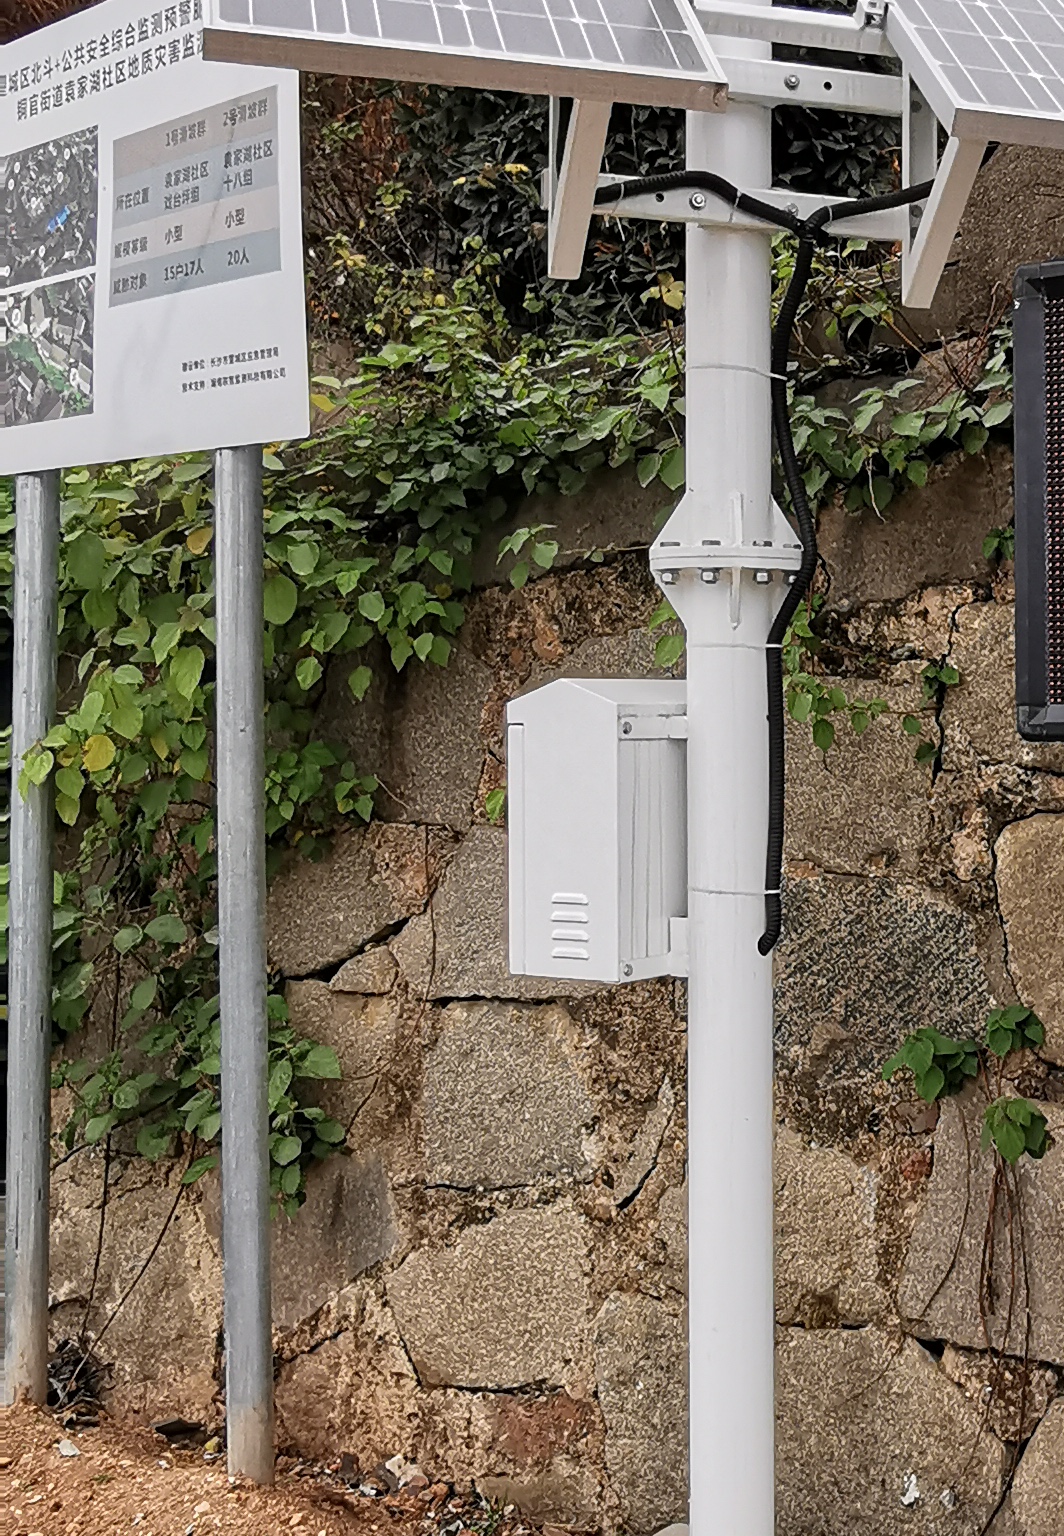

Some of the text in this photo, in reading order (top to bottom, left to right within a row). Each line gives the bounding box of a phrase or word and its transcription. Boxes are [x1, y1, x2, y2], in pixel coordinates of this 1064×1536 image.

[223, 169, 253, 193] 十八组
[225, 208, 246, 229] 小型
[165, 225, 184, 245] 小型
[164, 258, 205, 282] 15户17人
[227, 247, 250, 267] 20人
